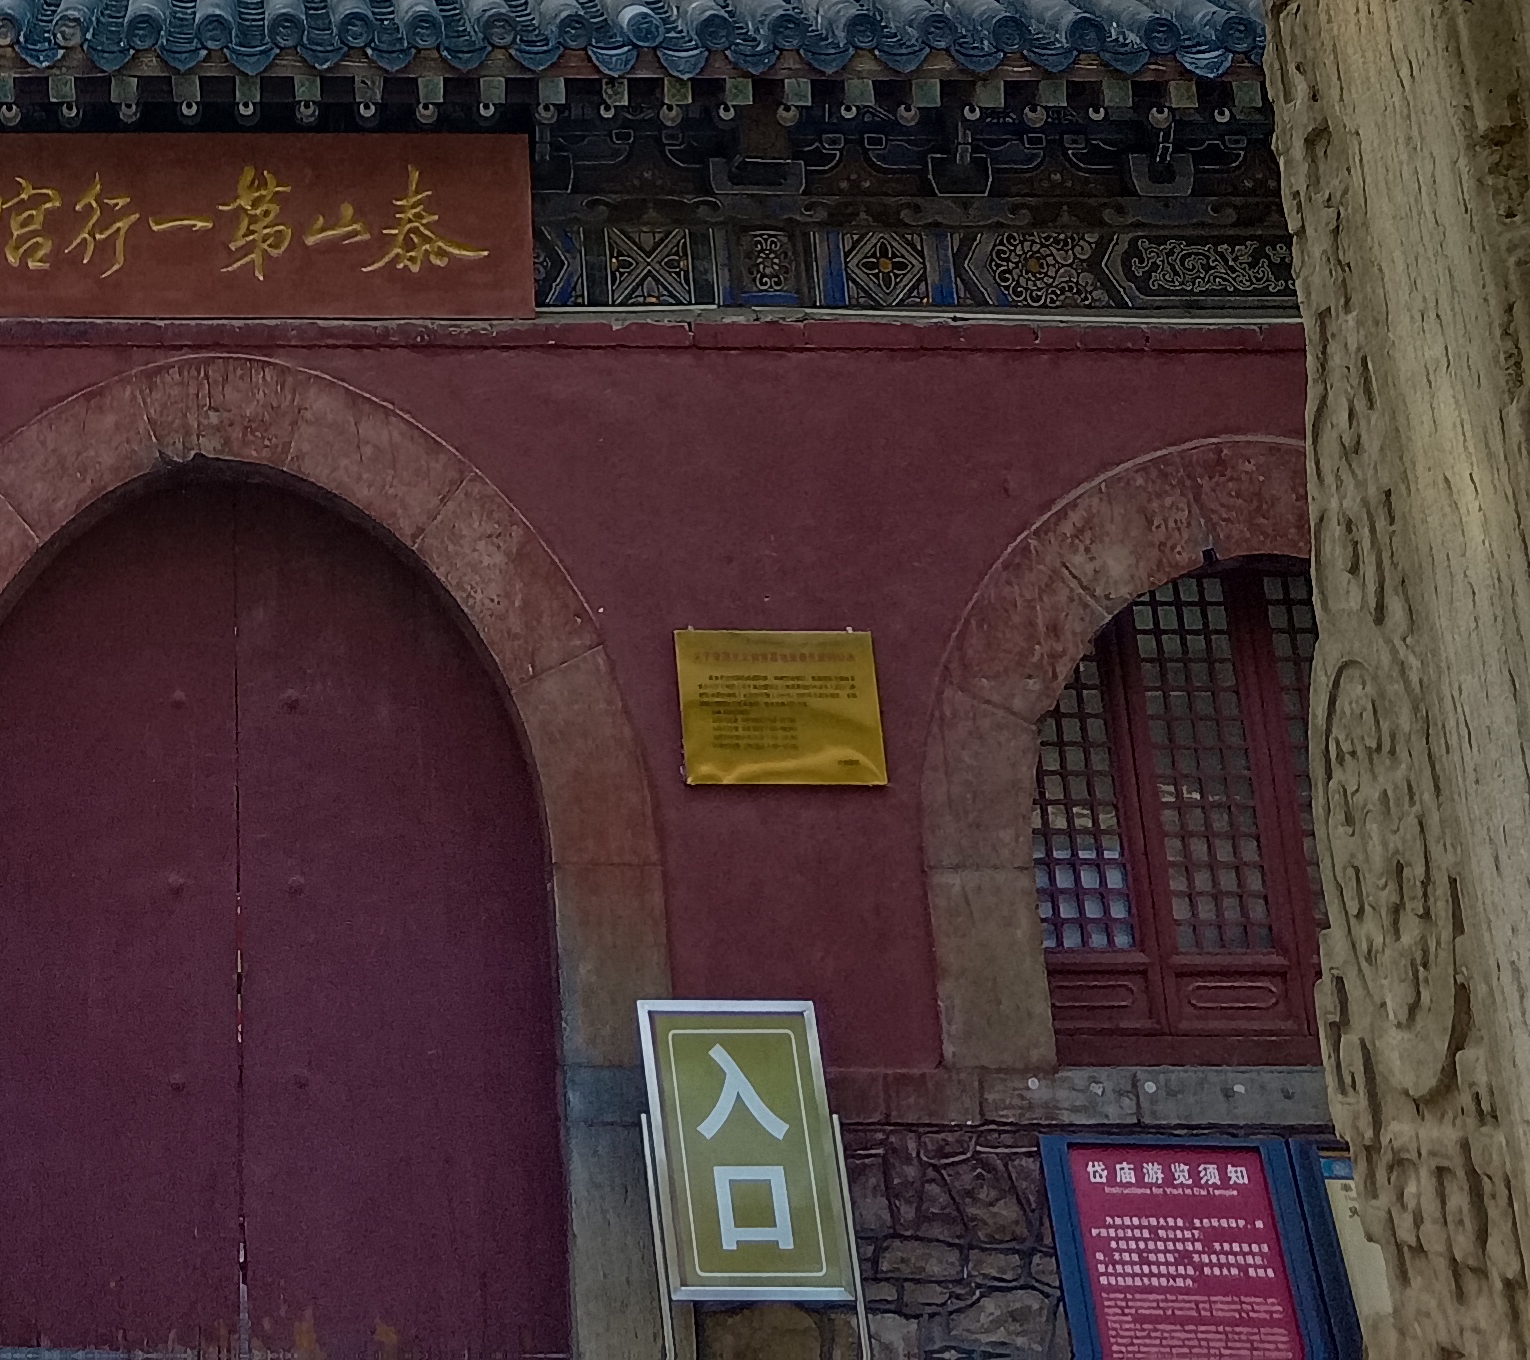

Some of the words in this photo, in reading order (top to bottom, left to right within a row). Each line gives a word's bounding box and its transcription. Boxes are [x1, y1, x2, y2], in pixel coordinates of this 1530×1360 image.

[696, 1043, 795, 1251] 入口
[1087, 1161, 1249, 1185] 岱庙游览须知
